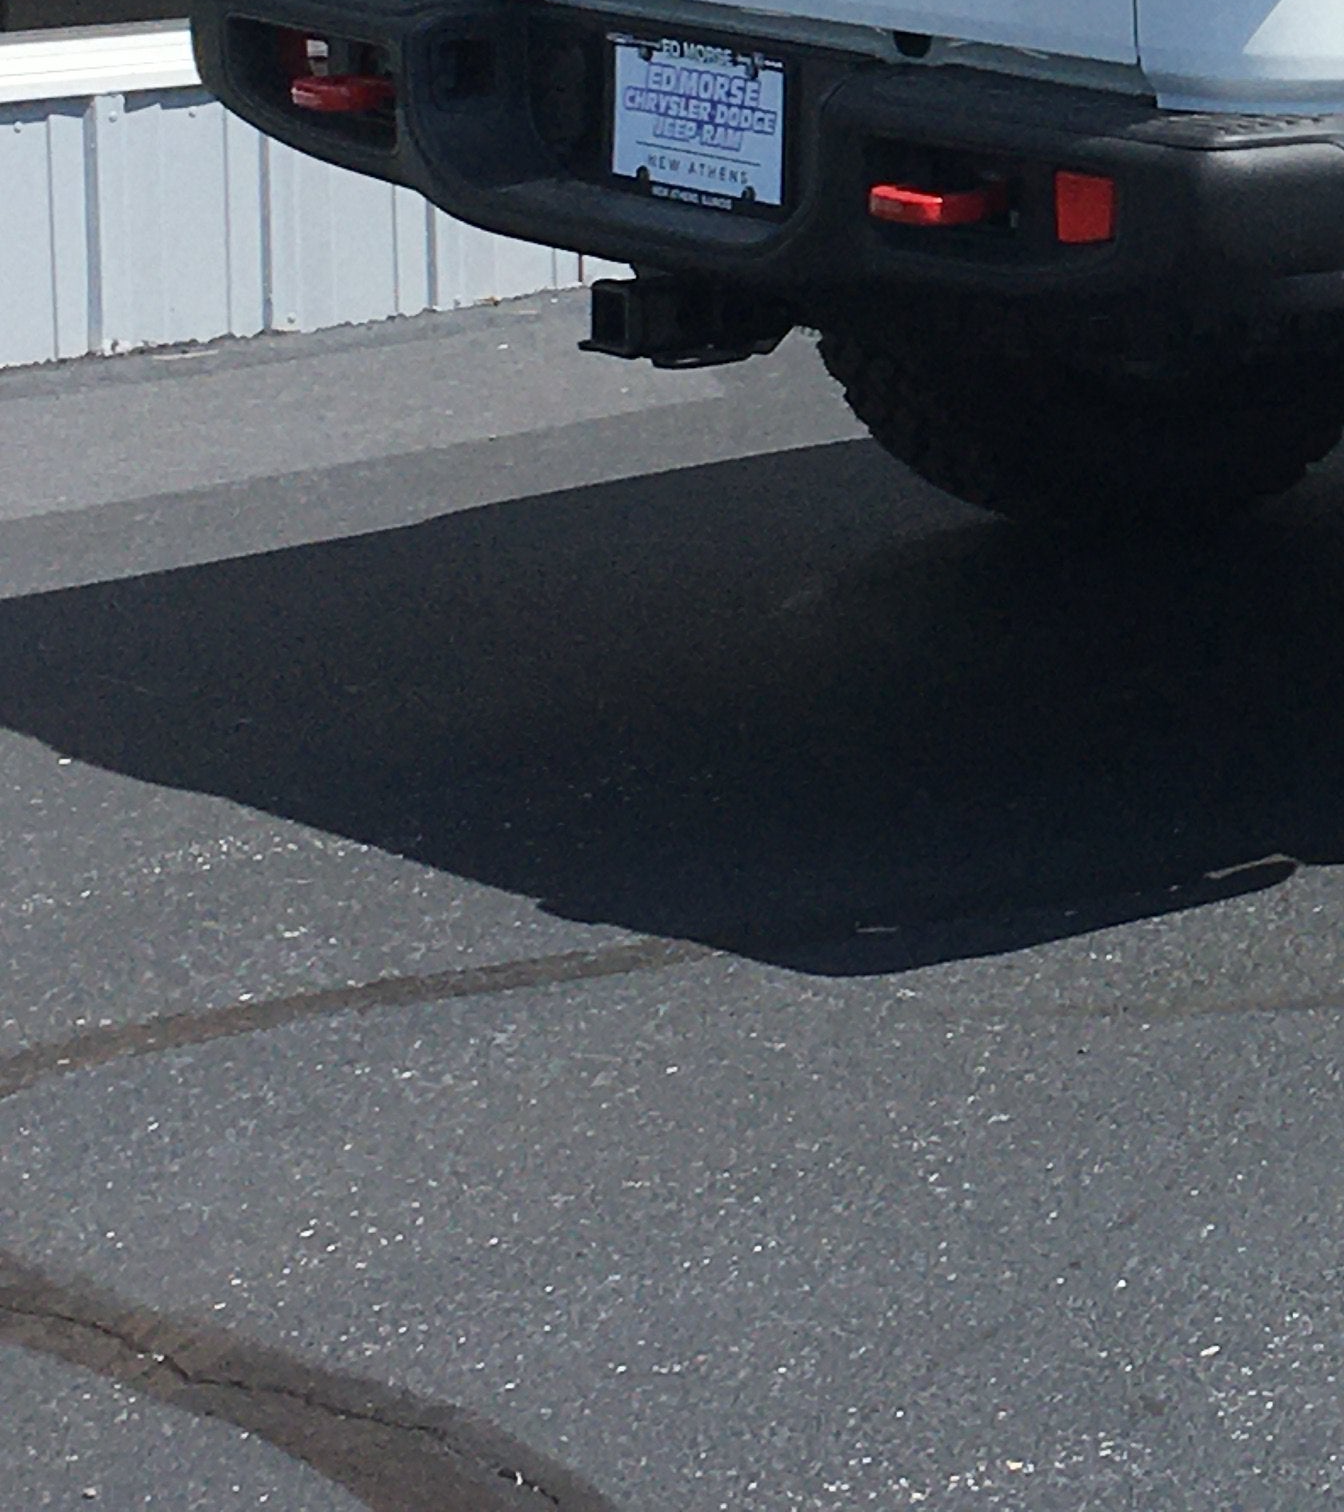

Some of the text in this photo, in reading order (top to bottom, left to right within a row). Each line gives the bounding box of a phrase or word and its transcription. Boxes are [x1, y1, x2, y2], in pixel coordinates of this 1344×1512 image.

[648, 62, 761, 107] ED MORSE
[648, 153, 749, 185] NEW ATHENS
